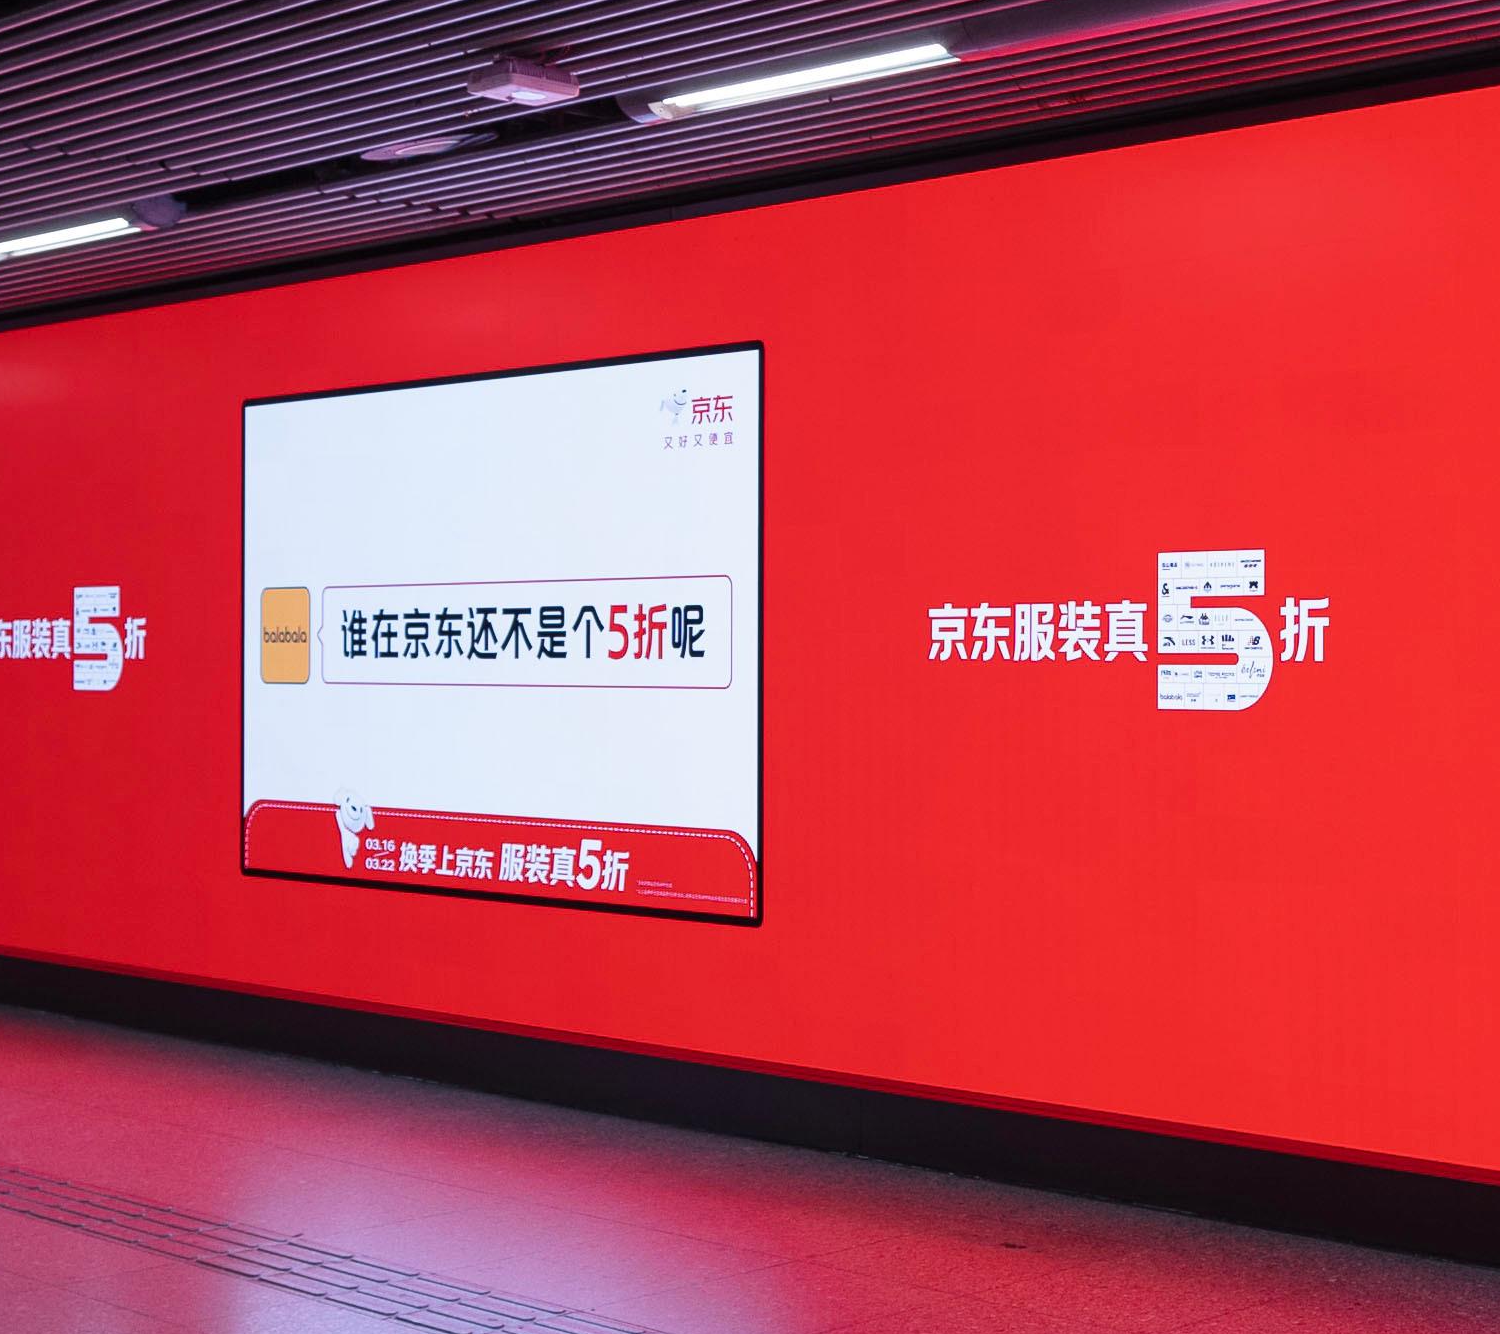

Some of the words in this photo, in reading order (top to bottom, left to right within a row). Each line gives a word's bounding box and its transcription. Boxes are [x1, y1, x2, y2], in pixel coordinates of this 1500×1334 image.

[691, 394, 734, 425] 京东
[663, 431, 733, 450] 又好又便宜
[263, 625, 308, 644] balabala
[340, 603, 706, 662] 谁在京东还不是个5折呢
[927, 548, 1331, 711] 京东服装真5折
[365, 837, 395, 852] 03.16
[365, 858, 395, 872] 03.22
[398, 841, 494, 880] 换季上京东
[499, 838, 631, 892] 服装真5折
